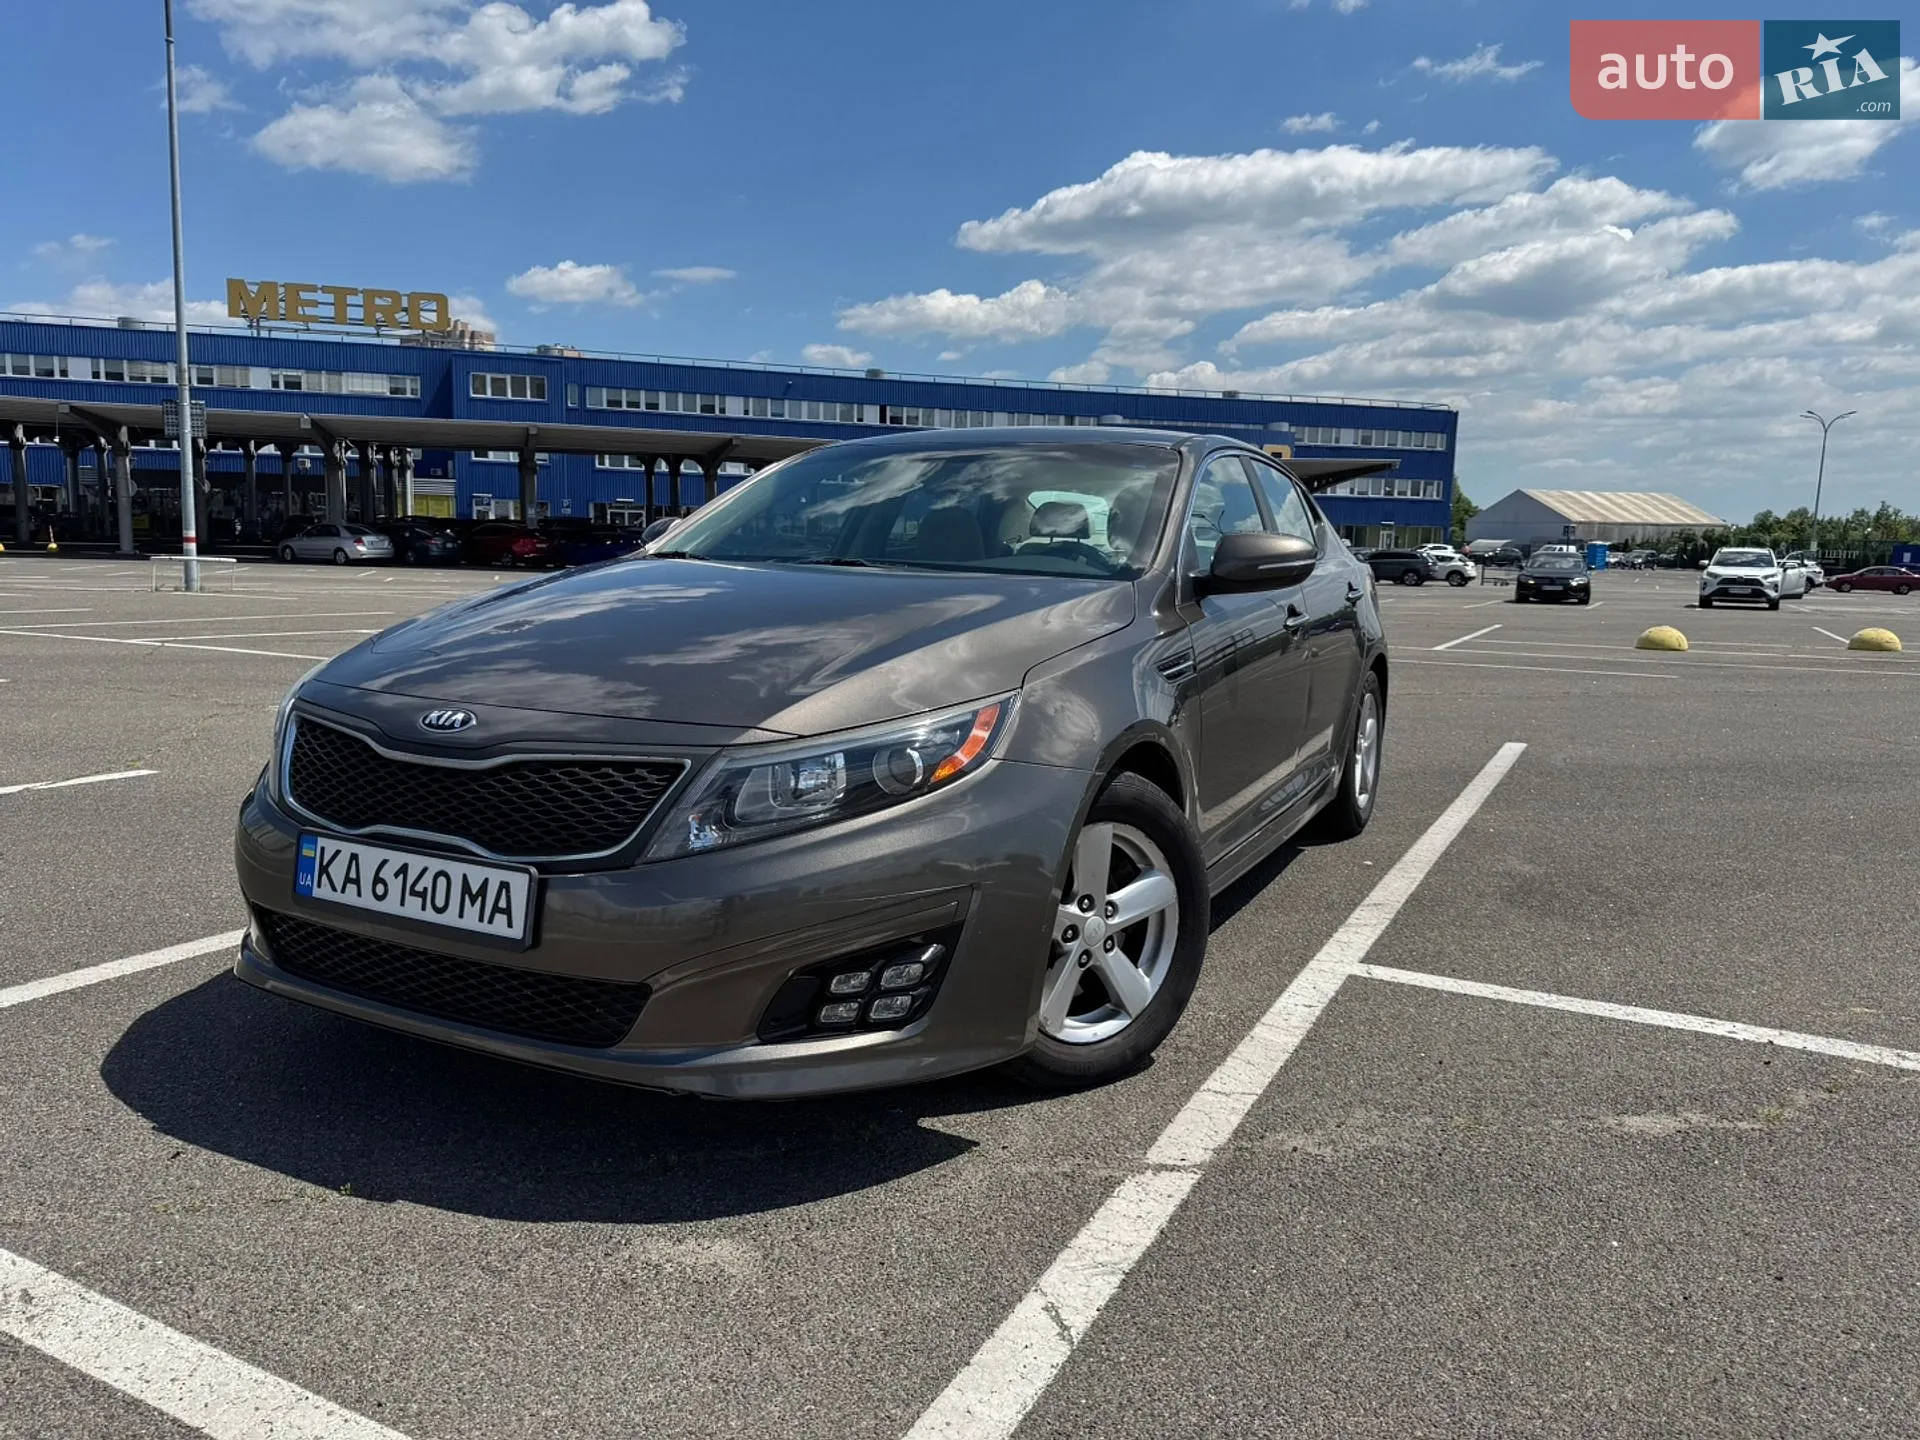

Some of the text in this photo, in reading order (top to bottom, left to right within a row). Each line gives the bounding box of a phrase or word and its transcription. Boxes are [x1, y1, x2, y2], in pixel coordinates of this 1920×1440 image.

[226, 277, 450, 332] METRO
[424, 710, 466, 728] KIA
[299, 871, 312, 888] UA
